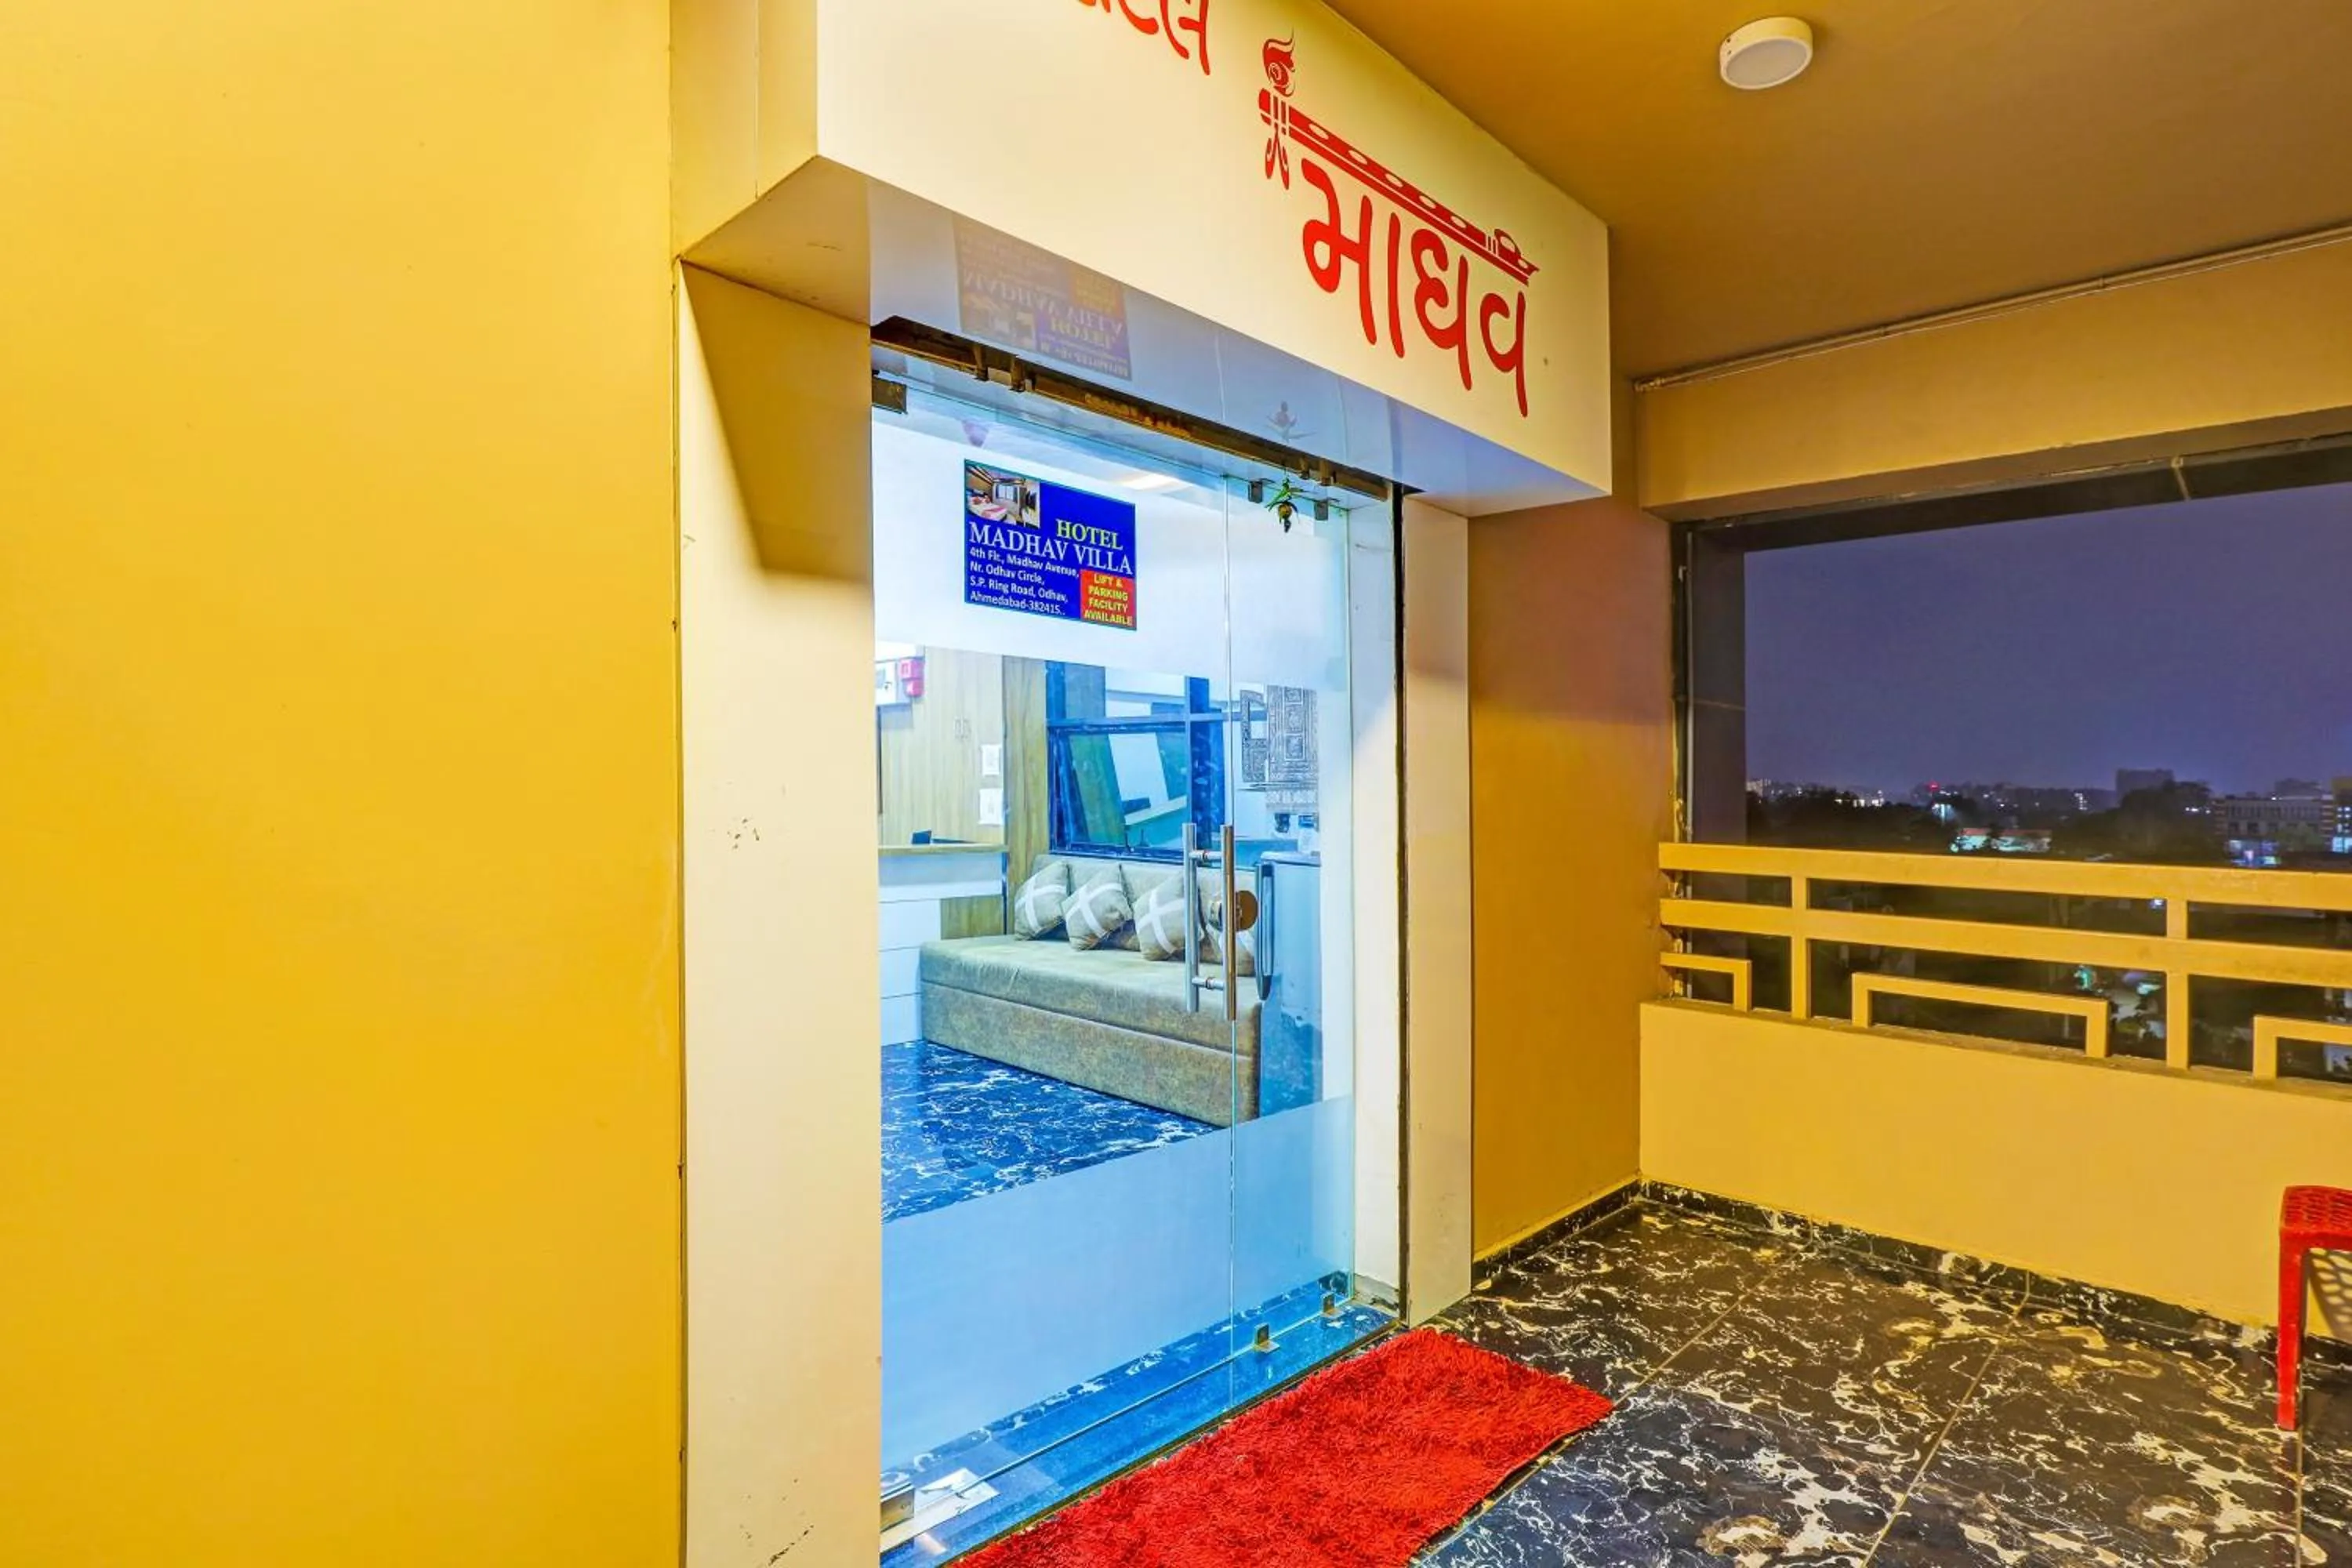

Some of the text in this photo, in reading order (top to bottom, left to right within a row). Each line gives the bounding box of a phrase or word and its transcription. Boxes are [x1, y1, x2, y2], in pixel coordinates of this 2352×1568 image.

[1301, 158, 1530, 418] માધવ
[1055, 518, 1123, 550] HOTEL
[969, 521, 1133, 575] MADHAV VILLA
[970, 546, 985, 559] 4th
[1007, 554, 1044, 570] Madhav
[1045, 561, 1080, 579] Avenue,
[970, 561, 1045, 585] Nr. Odhav Circle,
[970, 575, 1069, 604] S.P. Ring Road, Odhav,
[1094, 573, 1113, 586] LIFT
[1088, 585, 1128, 601] PARKING
[1089, 597, 1129, 613] FACILITY
[1084, 609, 1133, 626] AVAILABLE
